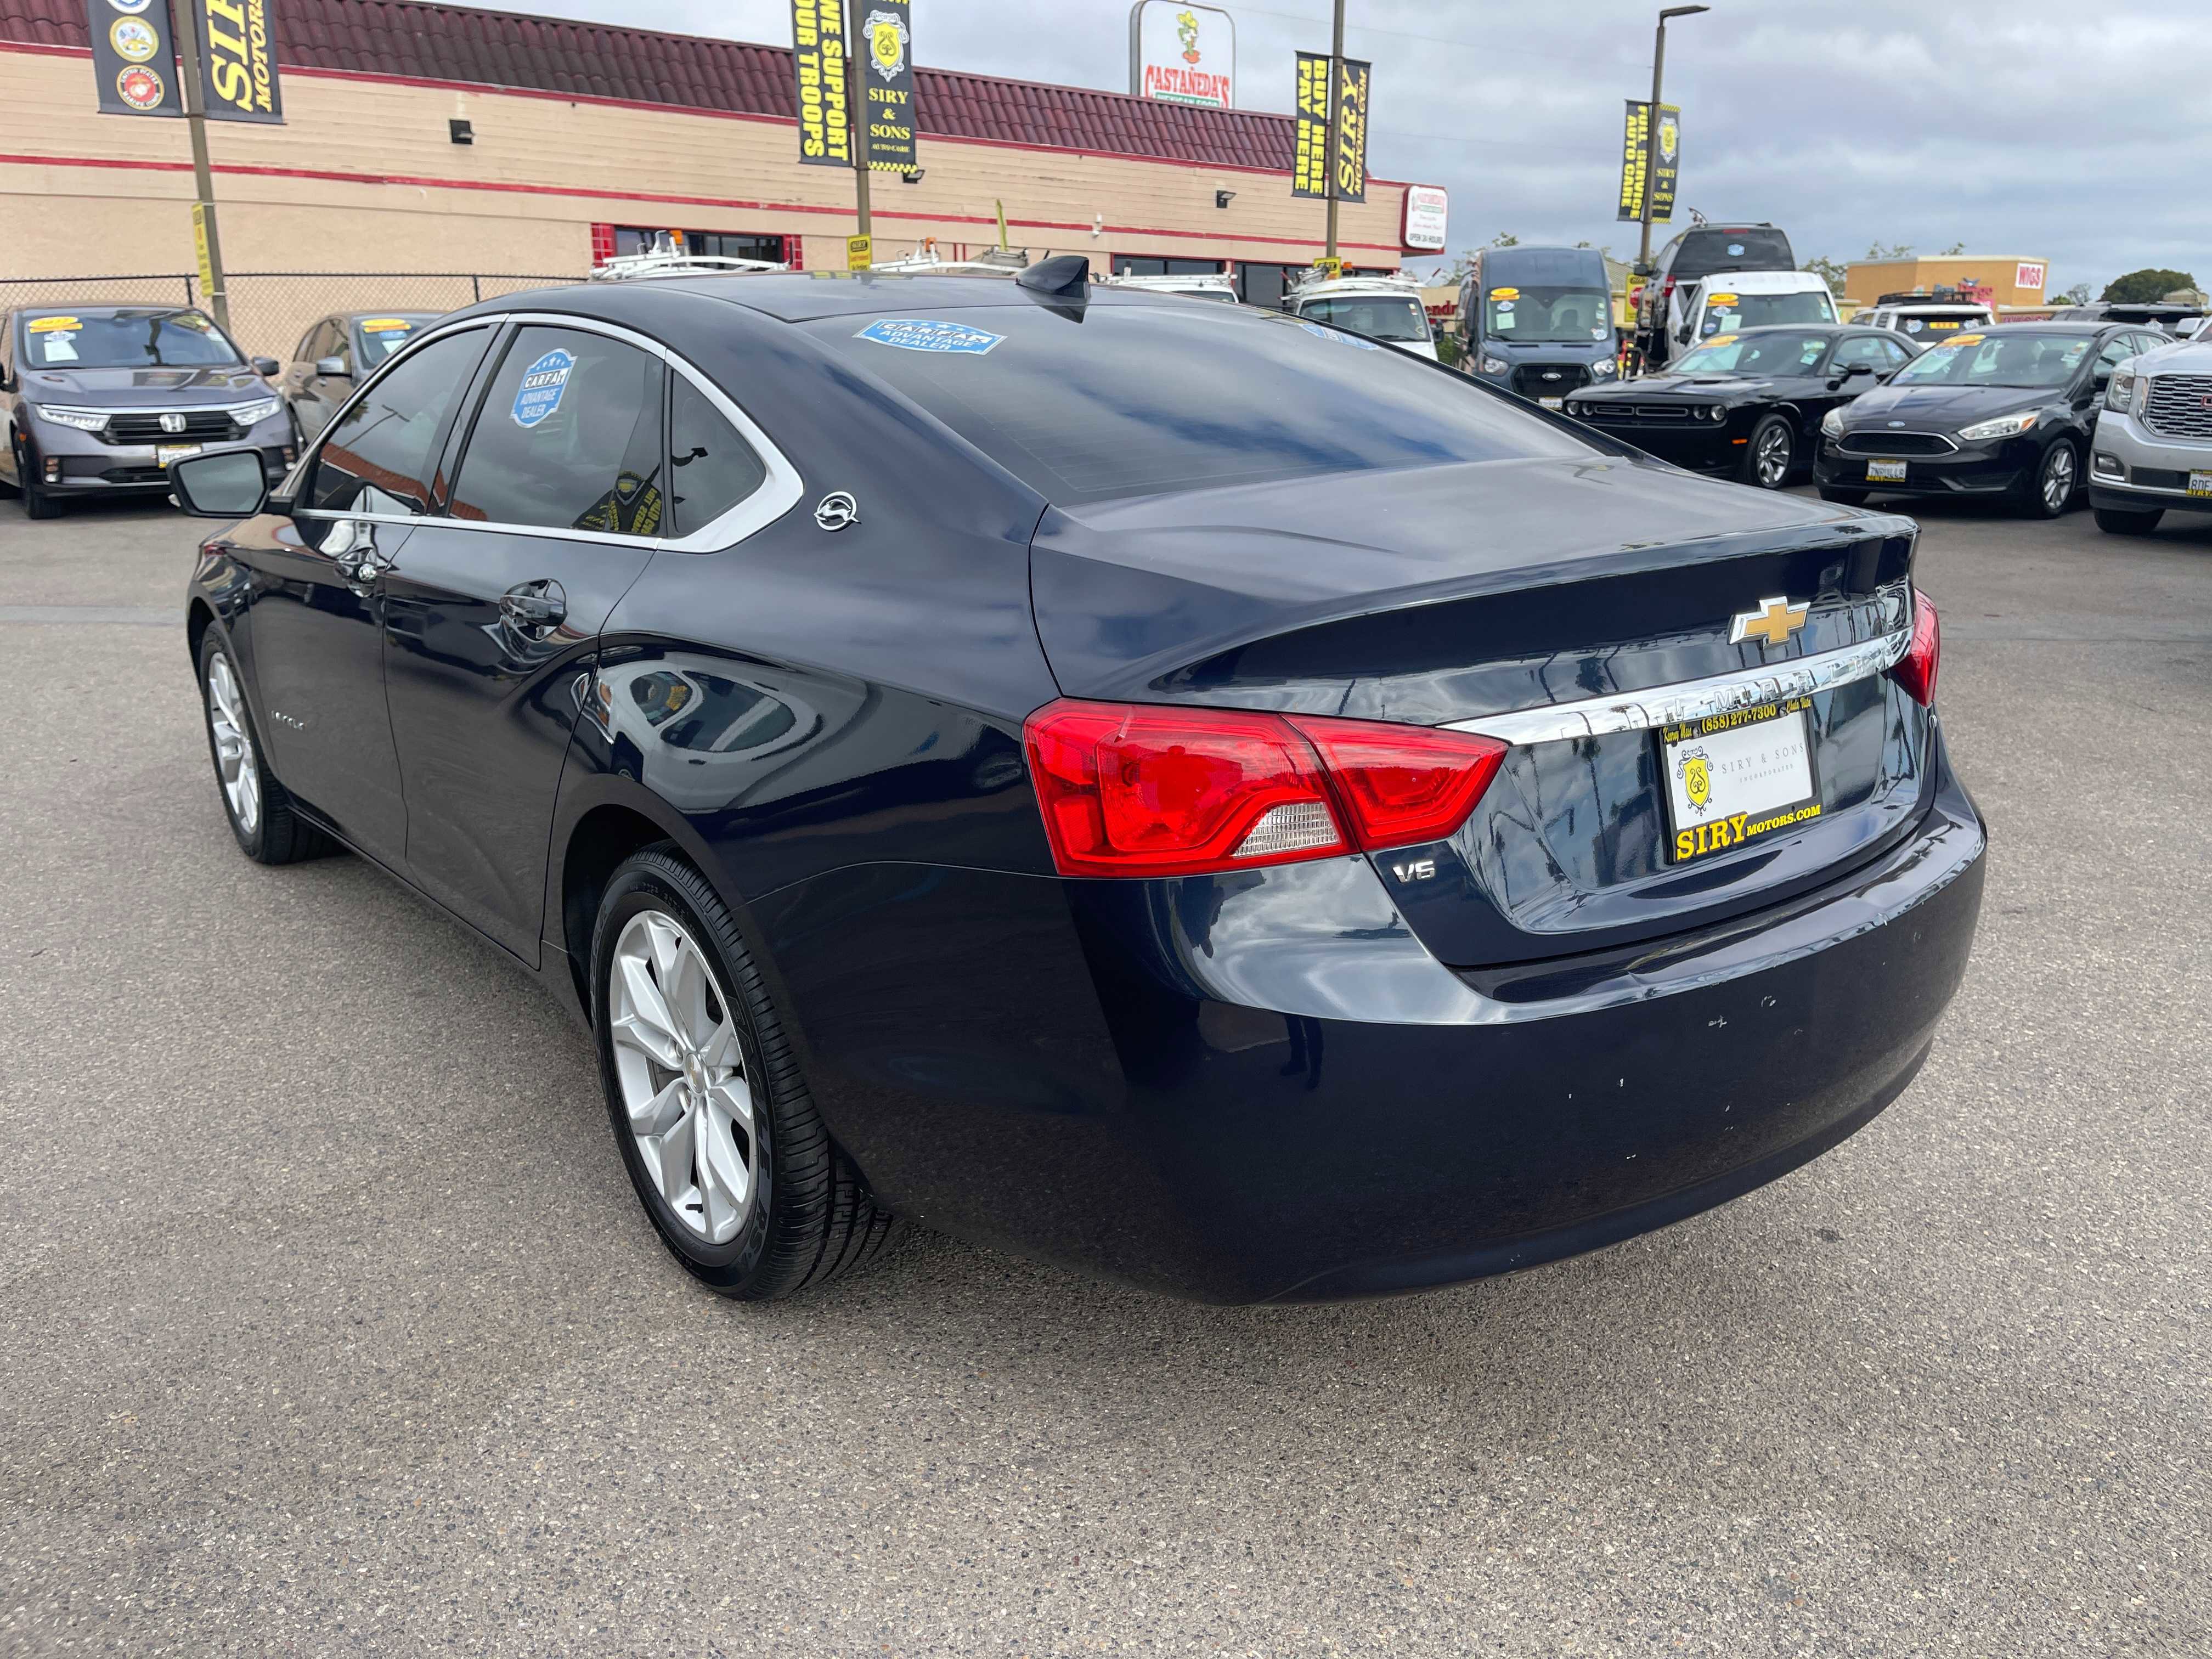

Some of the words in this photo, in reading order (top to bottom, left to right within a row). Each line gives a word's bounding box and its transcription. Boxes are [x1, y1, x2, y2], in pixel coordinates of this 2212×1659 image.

[821, 39, 849, 161] SUPPORT
[868, 88, 909, 105] SIRY
[1298, 60, 1312, 115] PAY
[1312, 60, 1327, 120] BUY
[798, 52, 825, 157] TROOPS
[882, 108, 896, 120] &
[870, 123, 911, 140] SONS
[1339, 64, 1358, 195] SIRY
[1625, 115, 1638, 161] AUTO
[1637, 105, 1648, 143] FULL
[1295, 119, 1311, 190] HERE
[1310, 124, 1325, 194] HERE
[1621, 163, 1635, 207] CARE
[1629, 149, 1647, 219] SERVICE
[2019, 267, 2041, 286] WIGS
[879, 323, 992, 344] CARFAX
[879, 330, 974, 347] ADVANTAGE
[888, 337, 952, 351] DEALER
[524, 369, 567, 388] CARFAX
[521, 387, 560, 405] ADVANTAGE
[521, 404, 546, 419] DEALER
[1702, 714, 1729, 733] (858)
[1730, 704, 1776, 726] 277-7300
[1722, 757, 1751, 774] SIRY
[1761, 753, 1768, 764] &
[1775, 742, 1804, 760] SONS
[1740, 763, 1793, 783] INCORPORATED
[1677, 813, 1748, 861] SIRY
[1746, 804, 1821, 837] MOTORS.COM
[1392, 861, 1435, 883] V6
